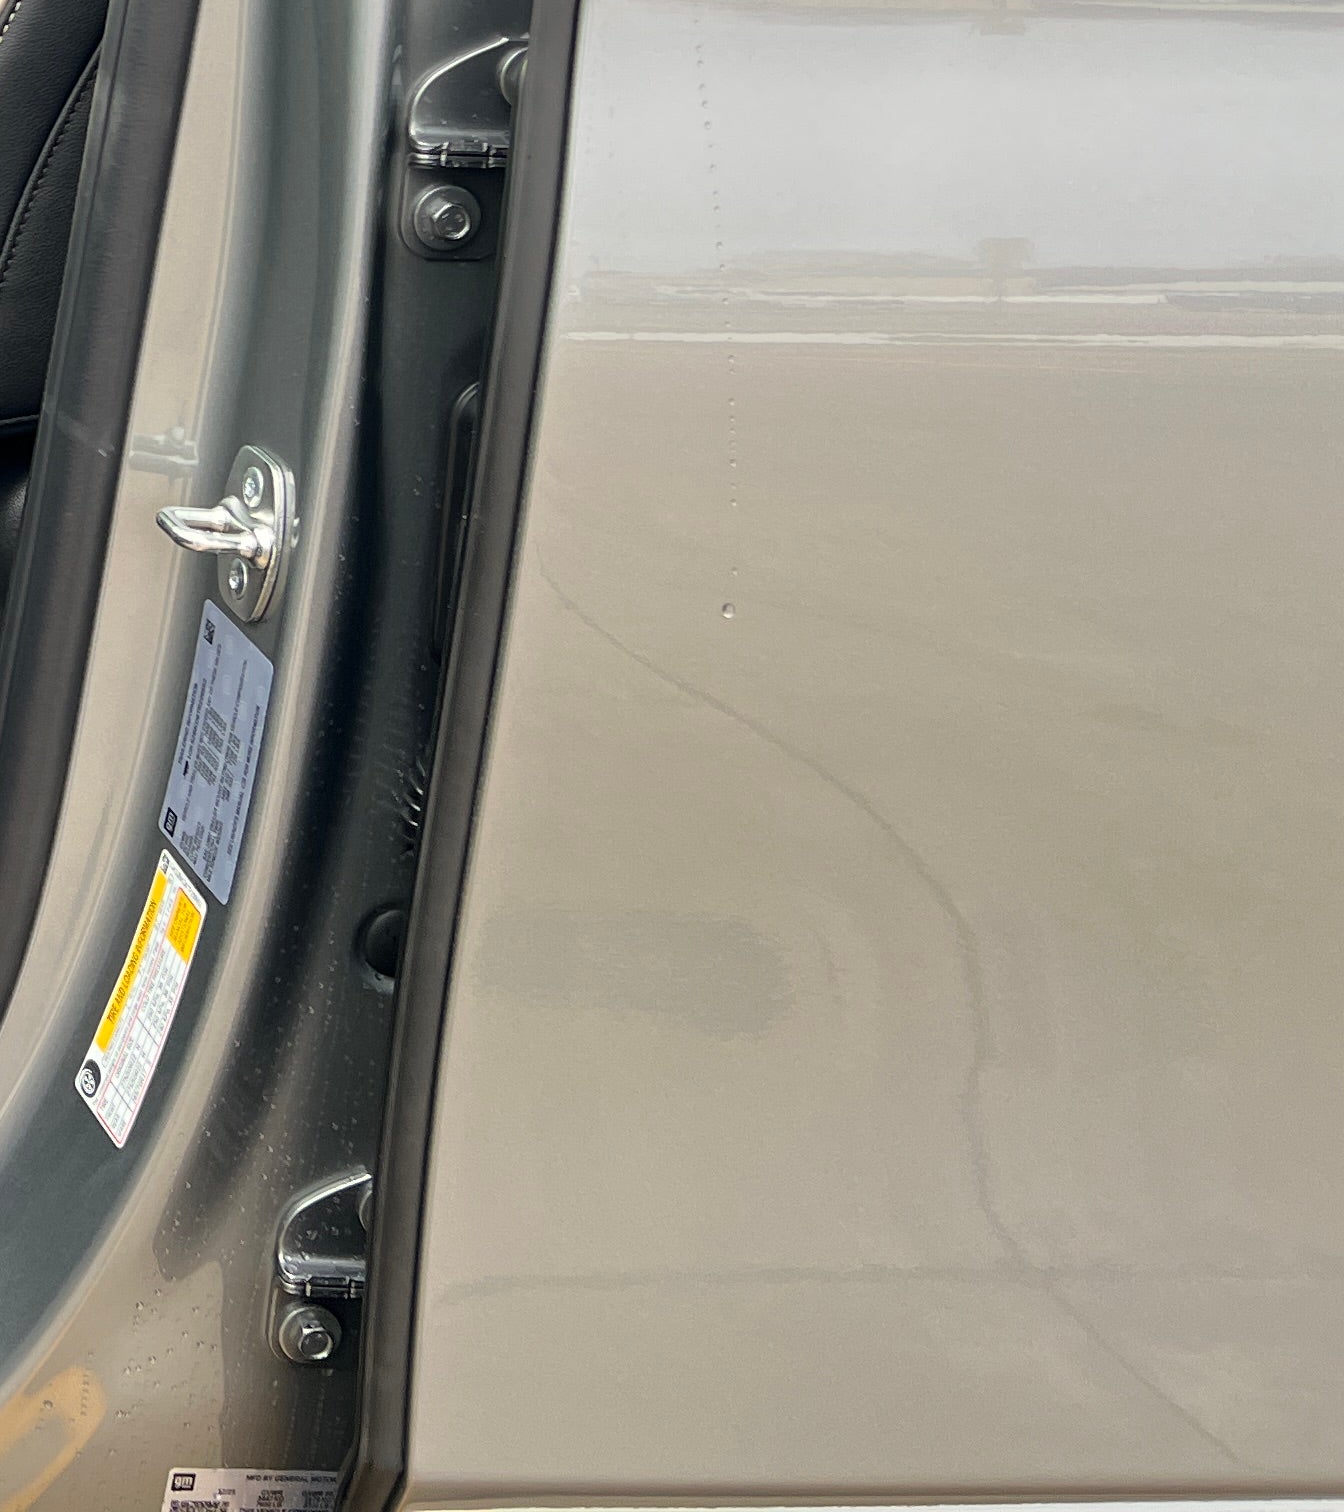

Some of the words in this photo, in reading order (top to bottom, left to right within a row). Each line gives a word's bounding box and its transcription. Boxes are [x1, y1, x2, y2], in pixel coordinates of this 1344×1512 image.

[106, 1003, 120, 1026] TIRE
[113, 986, 126, 1007] AND
[121, 949, 140, 992] LOADING
[134, 899, 158, 951] INFORMATION
